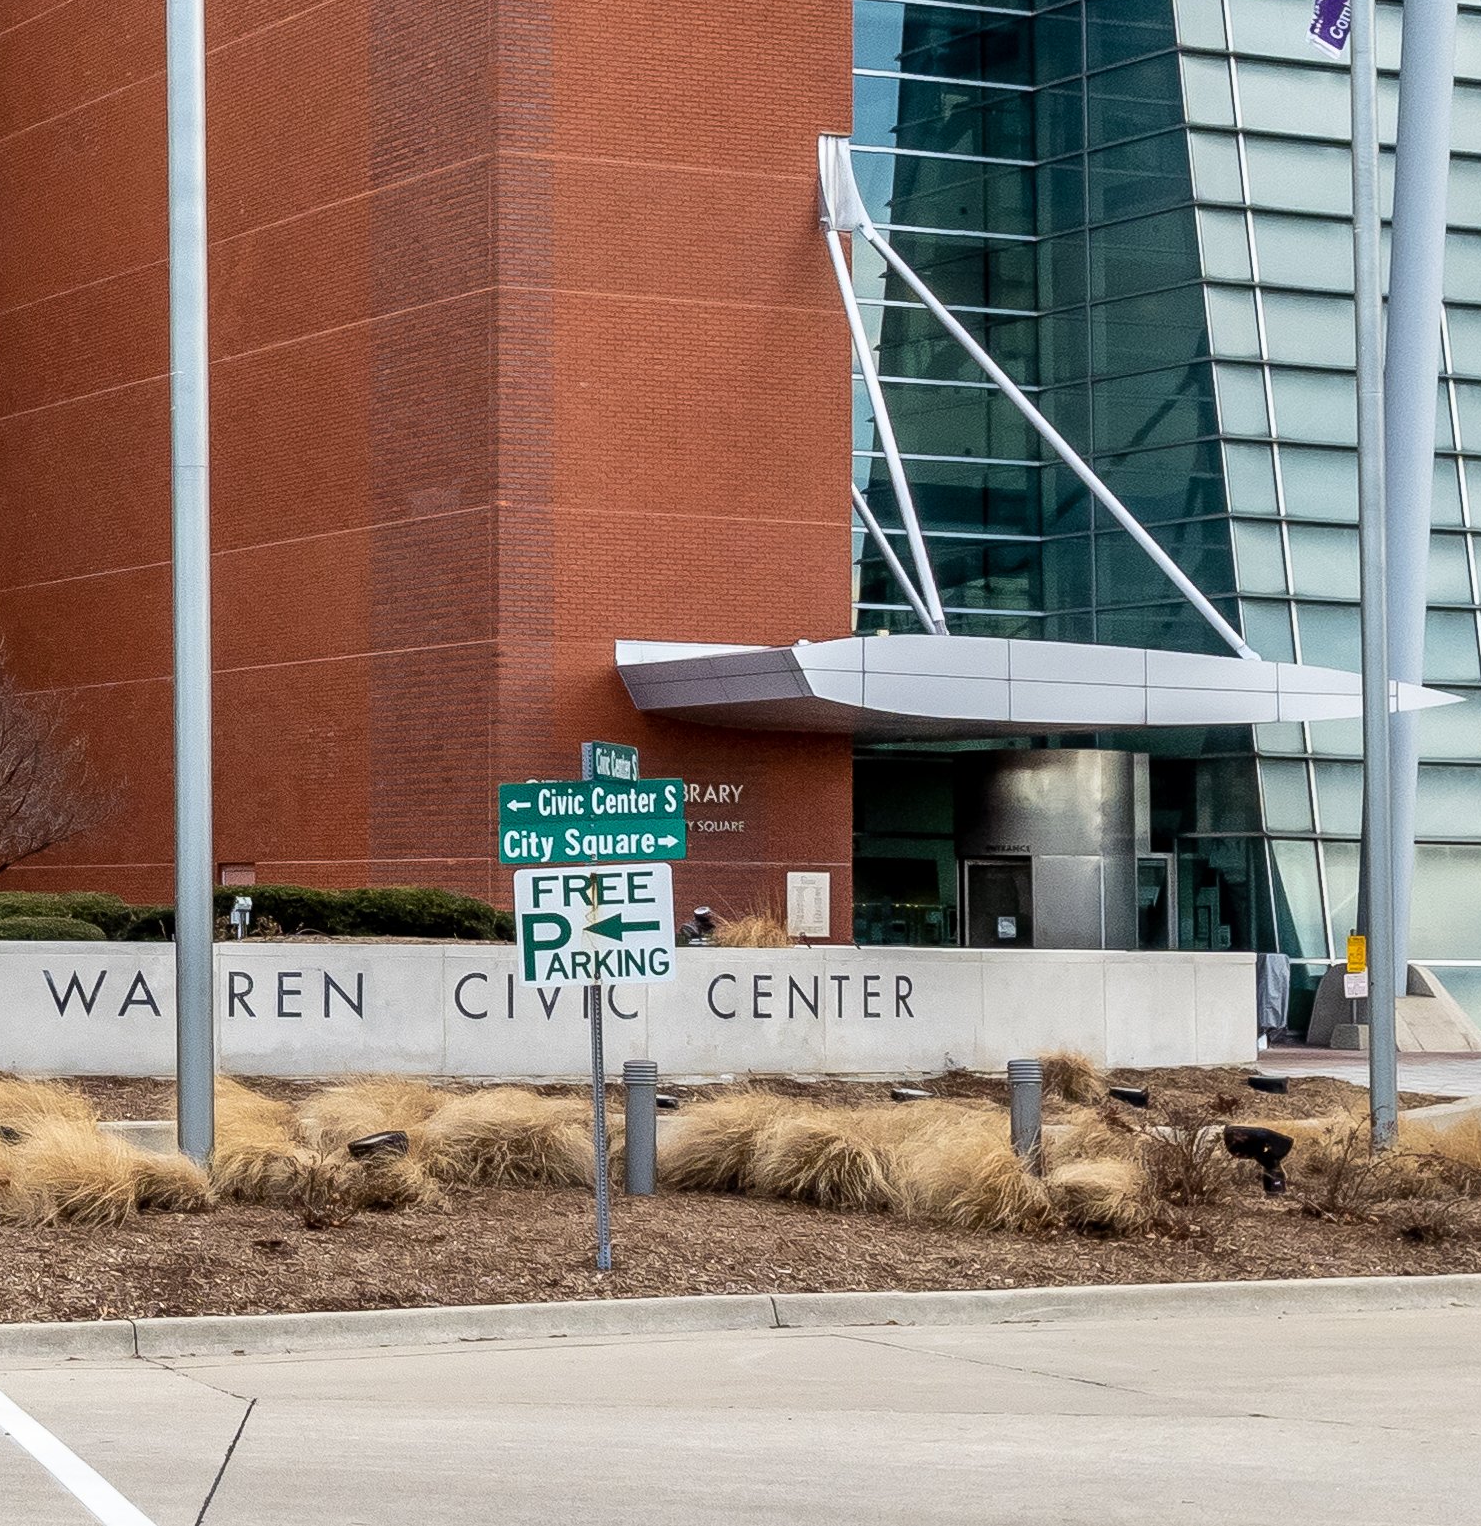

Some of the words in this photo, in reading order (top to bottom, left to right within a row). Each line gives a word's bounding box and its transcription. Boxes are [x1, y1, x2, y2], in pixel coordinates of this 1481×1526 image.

[538, 788, 584, 816] Civic
[591, 786, 657, 815] Center
[664, 785, 677, 813] S
[697, 820, 745, 833] SQUARE
[503, 830, 555, 863] City
[564, 828, 656, 861] Square
[532, 870, 656, 909] FREE
[521, 912, 670, 982] PARKING
[42, 969, 364, 1020] WAREN
[454, 972, 639, 1021] CIVIC
[707, 973, 915, 1021] CENTER
